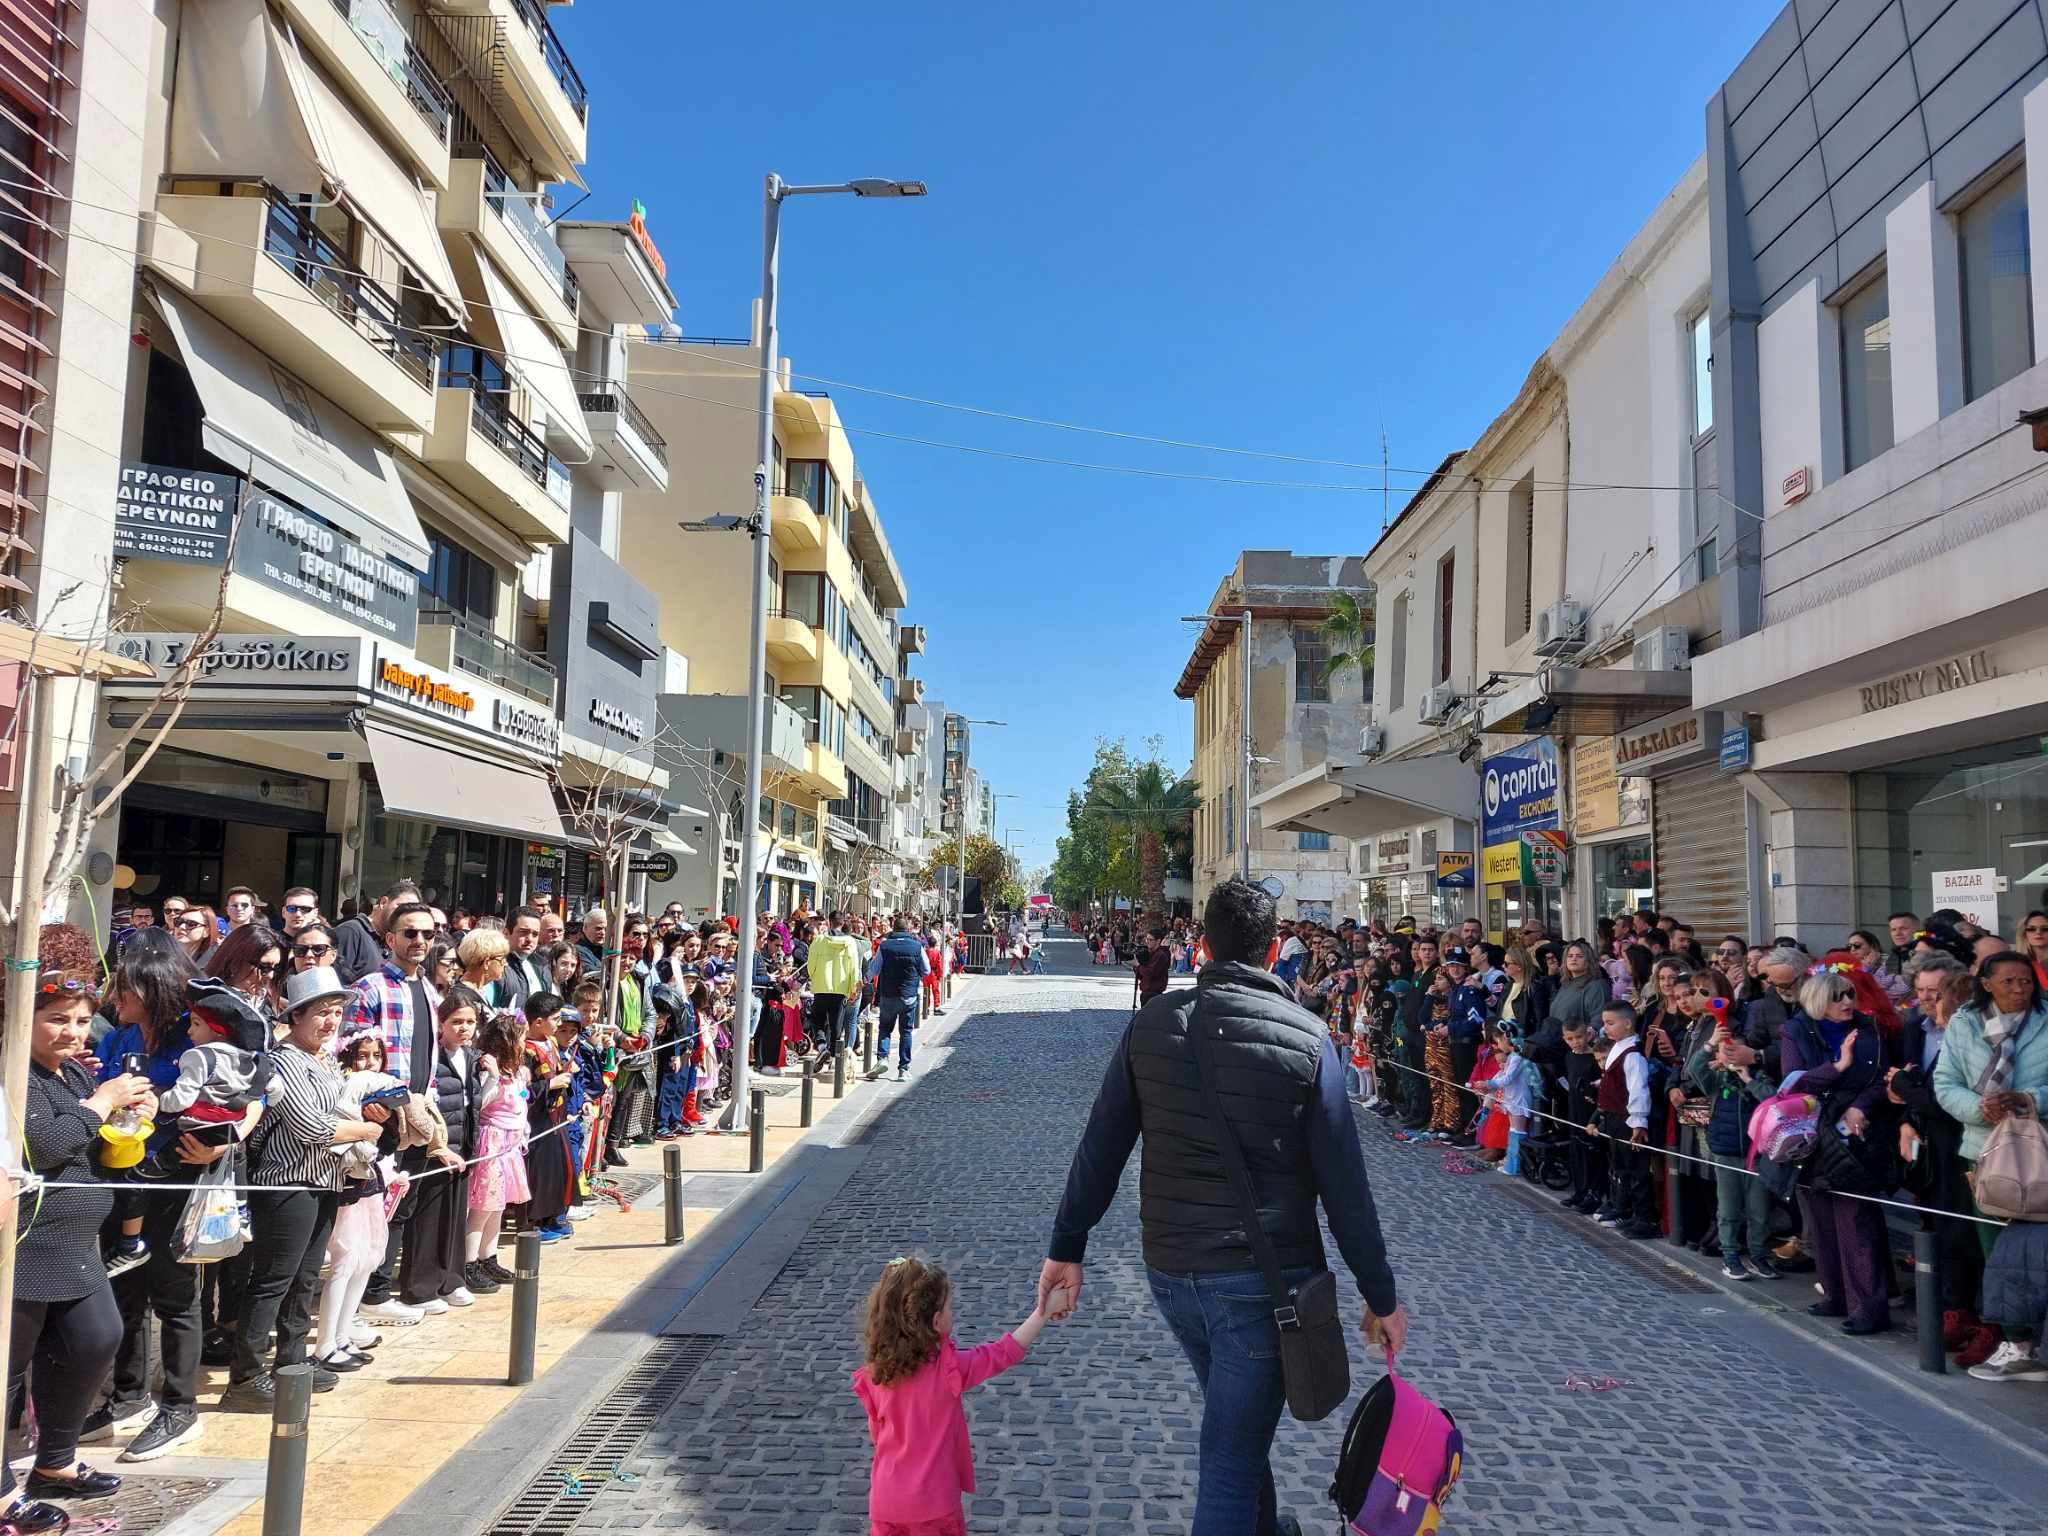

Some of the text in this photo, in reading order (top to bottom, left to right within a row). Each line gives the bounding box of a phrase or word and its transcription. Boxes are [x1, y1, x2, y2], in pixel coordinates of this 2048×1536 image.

[122, 468, 215, 494] ΓΡΑΦΕΙΟ
[118, 485, 224, 512] ΔΙΩΤΙΚΩΝ
[116, 502, 217, 529] ΕΡΕΥΝΩΝ
[260, 499, 334, 553] ΓΡΑΦΕΙΟ
[300, 551, 375, 602] ΕΡΕΥΝΩΝ
[341, 543, 415, 596] ΙΔΙΩΤΙΚΩΝ
[160, 639, 350, 675] Σβοϊδάκης
[383, 658, 422, 695] bakery
[423, 673, 432, 696] &
[1858, 650, 1999, 713] RUSTY NAIL
[1442, 855, 1470, 865] ATM
[1489, 855, 1517, 874] Western
[1944, 874, 1983, 888] BAZZAR
